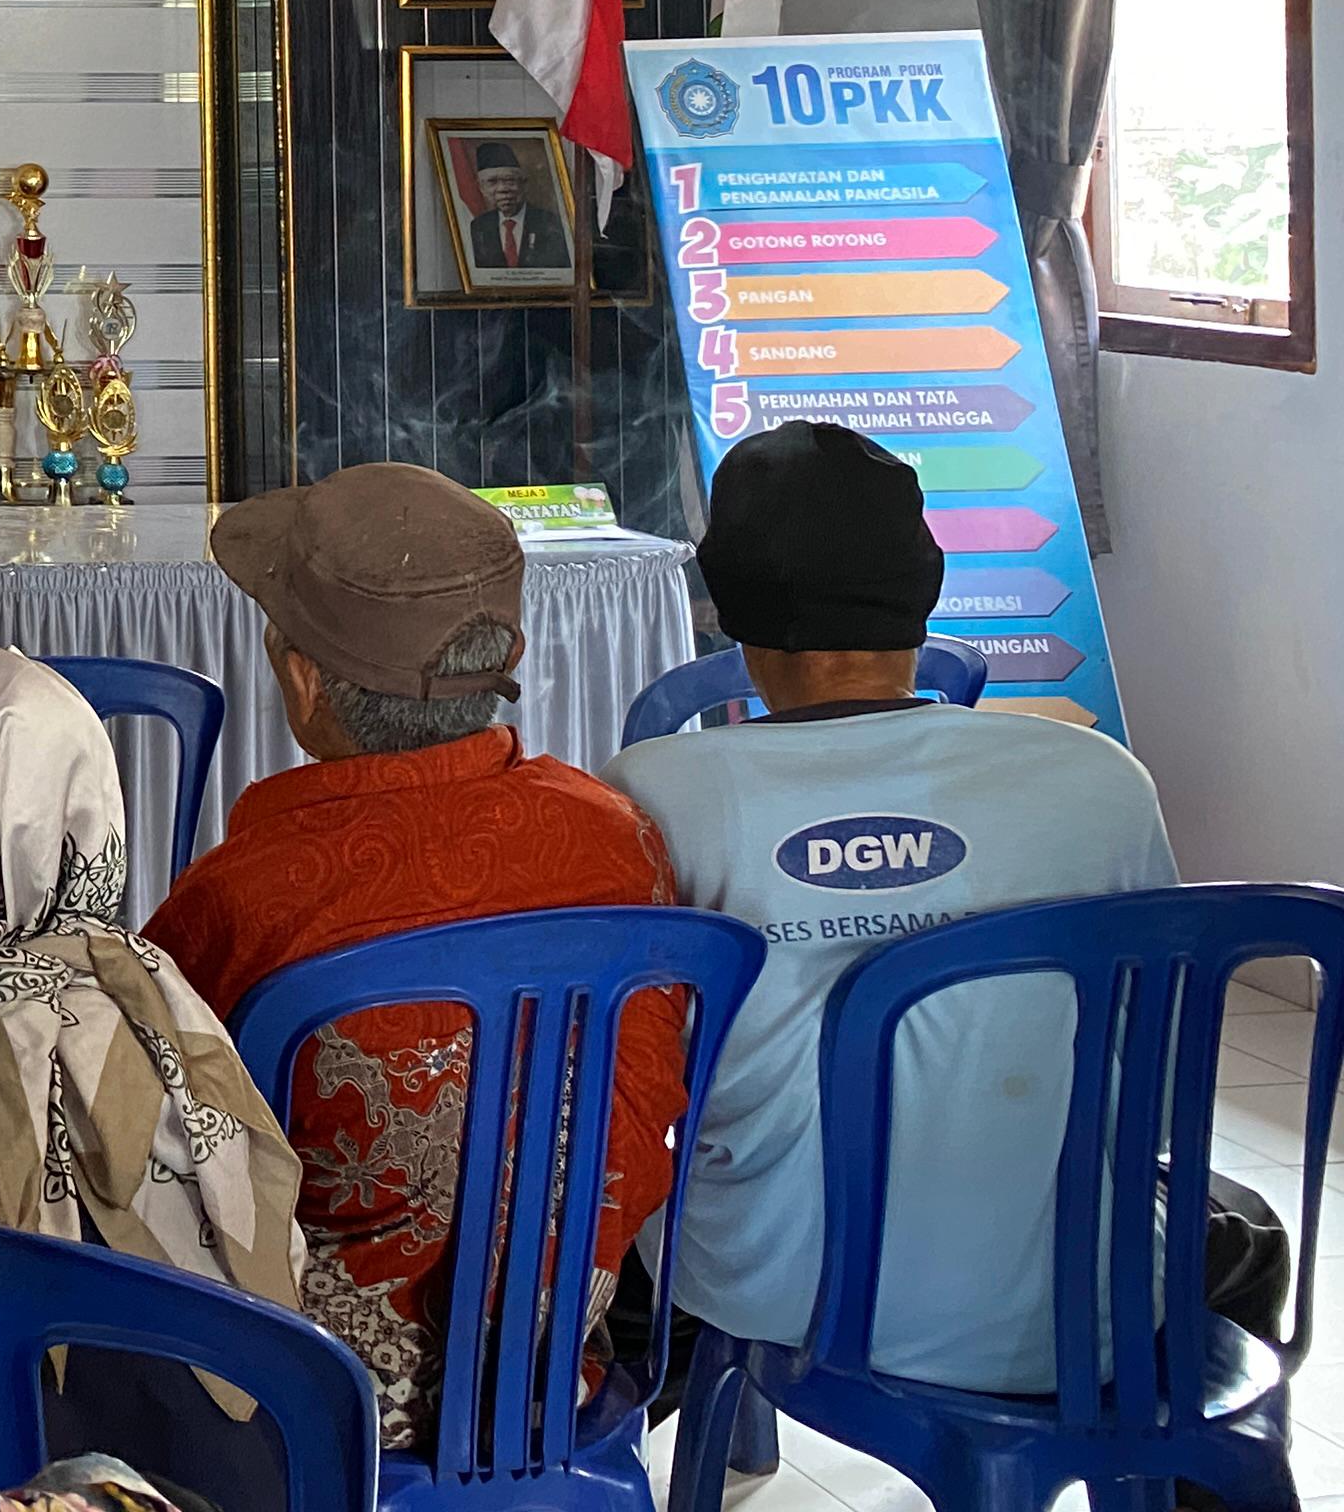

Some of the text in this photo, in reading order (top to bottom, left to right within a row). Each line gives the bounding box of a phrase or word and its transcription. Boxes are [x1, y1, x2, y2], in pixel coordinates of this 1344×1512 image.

[827, 64, 943, 79] PROGRAM POKOK
[752, 63, 827, 126] 10
[830, 78, 953, 125] PKK
[717, 168, 885, 186] PENGHAYATAN DAN
[670, 162, 702, 214] 1
[721, 185, 939, 205] PENGAMALAN PANCASILA
[678, 216, 721, 268] 2
[728, 233, 887, 250] GOTONG ROYONG
[688, 269, 731, 324] 3
[738, 289, 814, 304] PANGAN
[698, 325, 739, 379] 4
[749, 345, 837, 361] SANDANG
[710, 380, 751, 439] 5
[759, 390, 959, 409] PERUMAHAN DAN TATA
[848, 413, 911, 429] RUMAH
[915, 410, 993, 426] TANGGA
[507, 489, 538, 498] MEJA
[807, 831, 933, 875] DGW
[758, 921, 812, 944] SES
